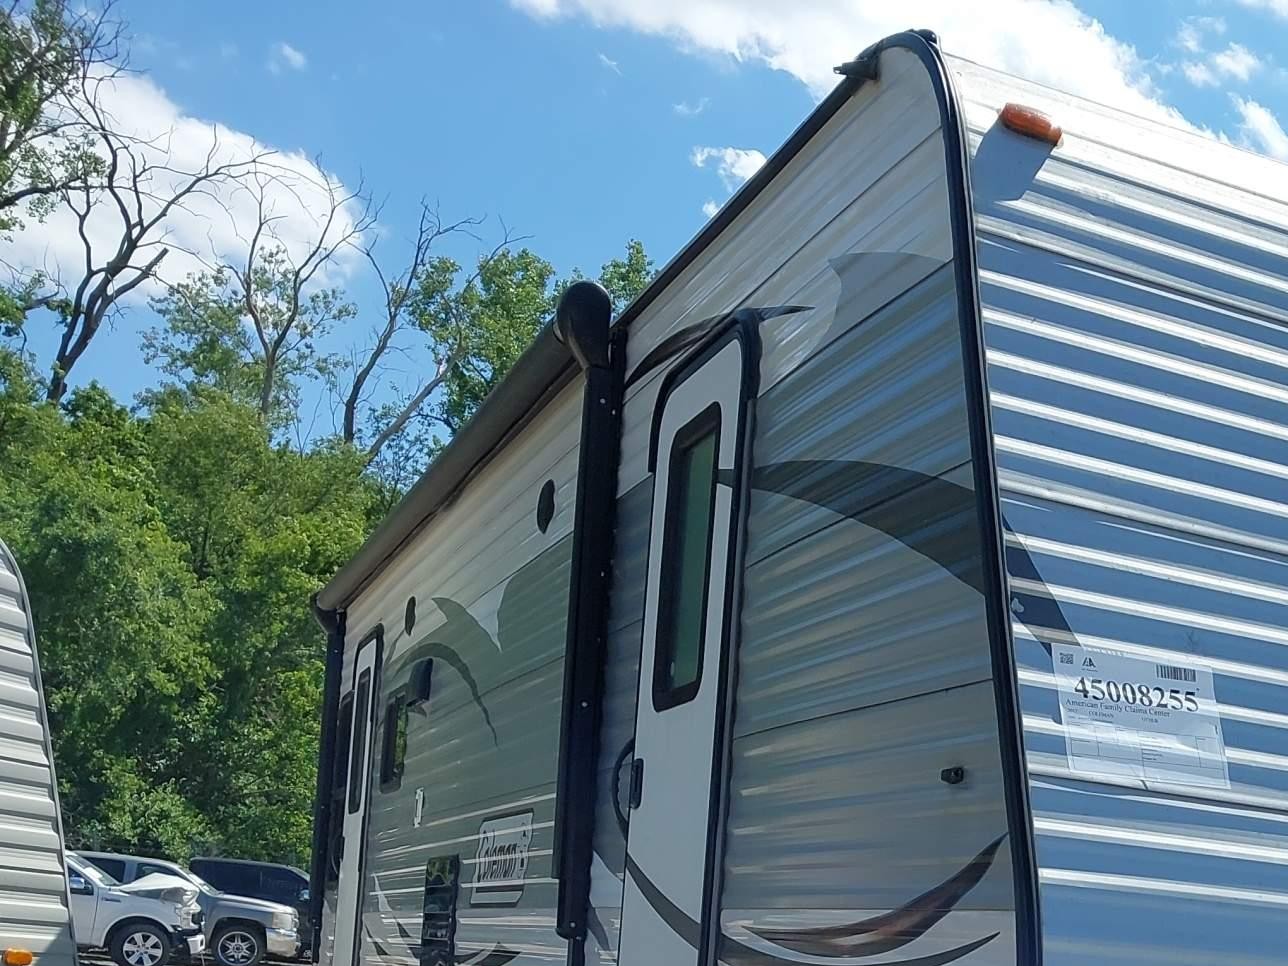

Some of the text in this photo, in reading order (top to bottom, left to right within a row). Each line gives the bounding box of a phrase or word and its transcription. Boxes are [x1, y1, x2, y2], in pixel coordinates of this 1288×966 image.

[1065, 698, 1171, 718] American Family Claims Center
[1074, 676, 1199, 712] 45008255
[477, 829, 518, 883] Coleman
